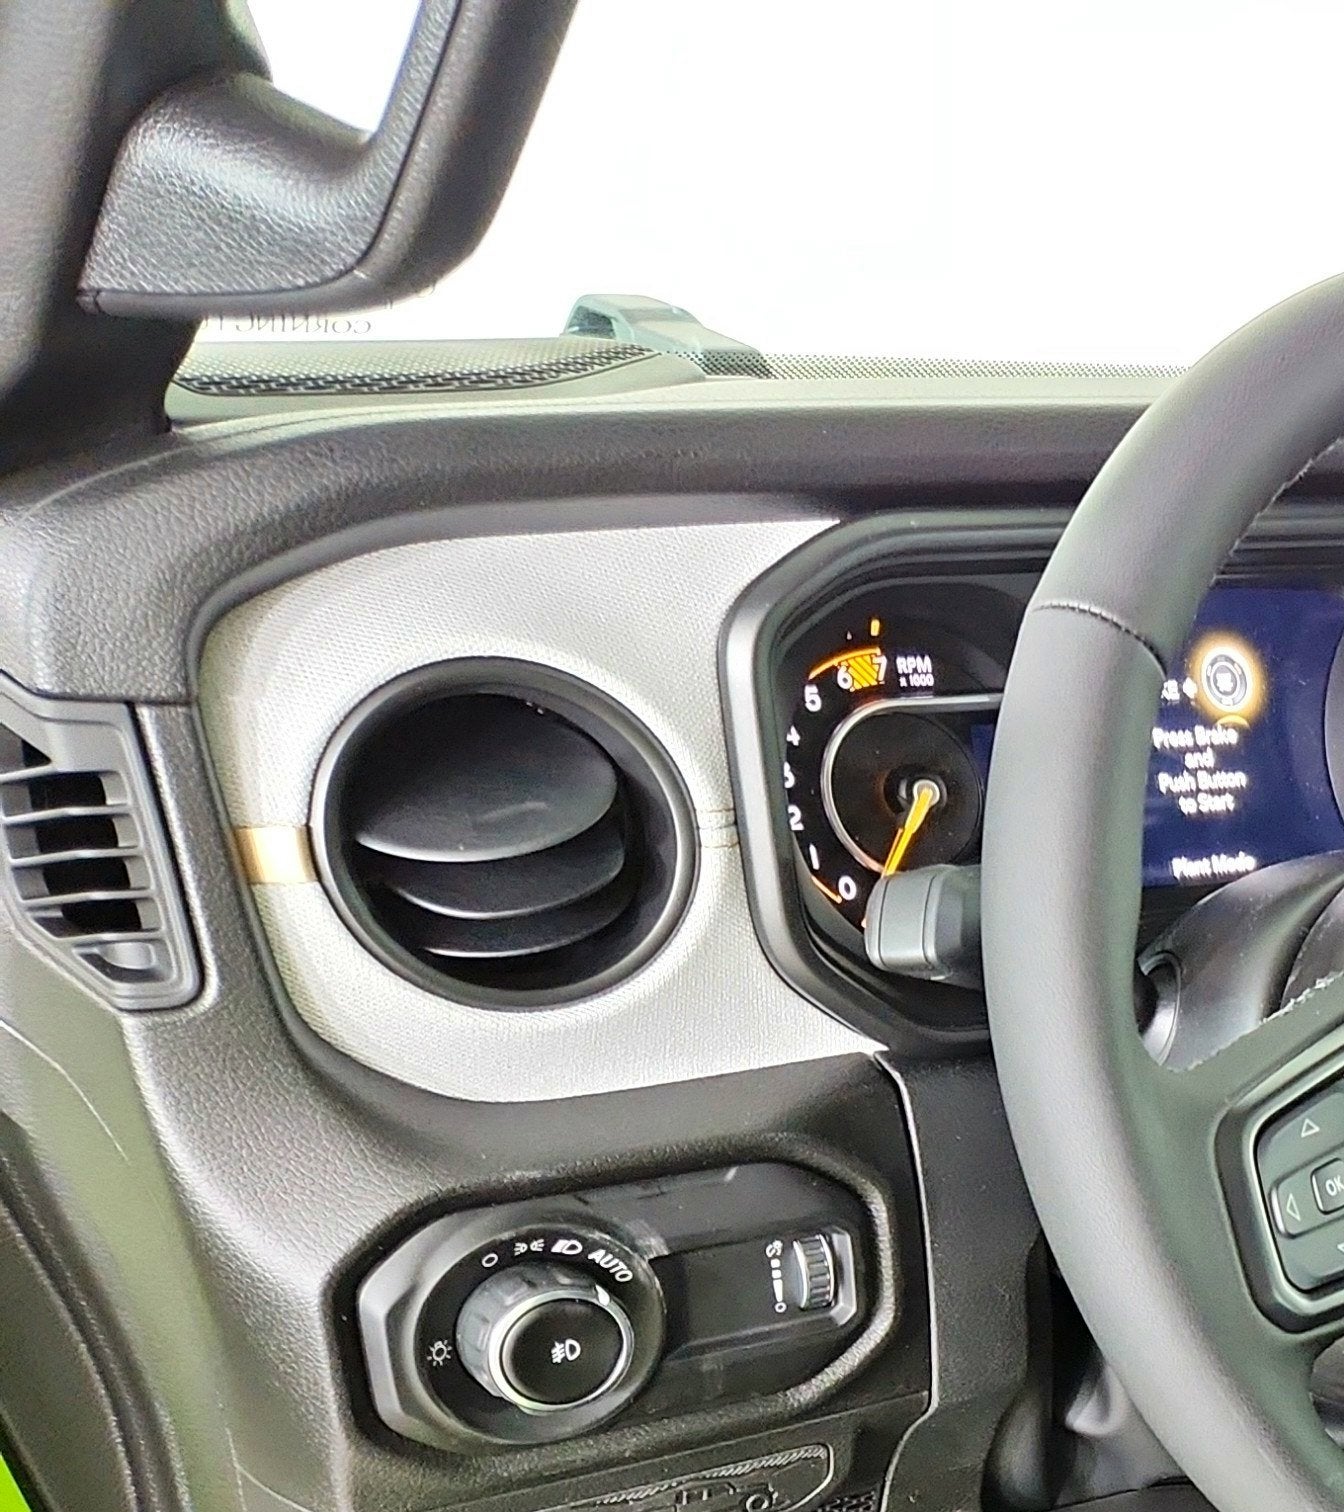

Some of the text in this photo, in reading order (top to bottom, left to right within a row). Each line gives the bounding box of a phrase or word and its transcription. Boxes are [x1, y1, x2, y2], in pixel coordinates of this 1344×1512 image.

[837, 663, 854, 690] 6
[872, 655, 888, 683] 7
[896, 654, 933, 674] RPM
[909, 673, 935, 688] 1000
[804, 684, 822, 713] 5
[786, 725, 801, 746] 4
[787, 804, 805, 831] 2
[808, 843, 820, 871] 1
[838, 875, 857, 901] 0
[587, 1248, 635, 1285] AUTO
